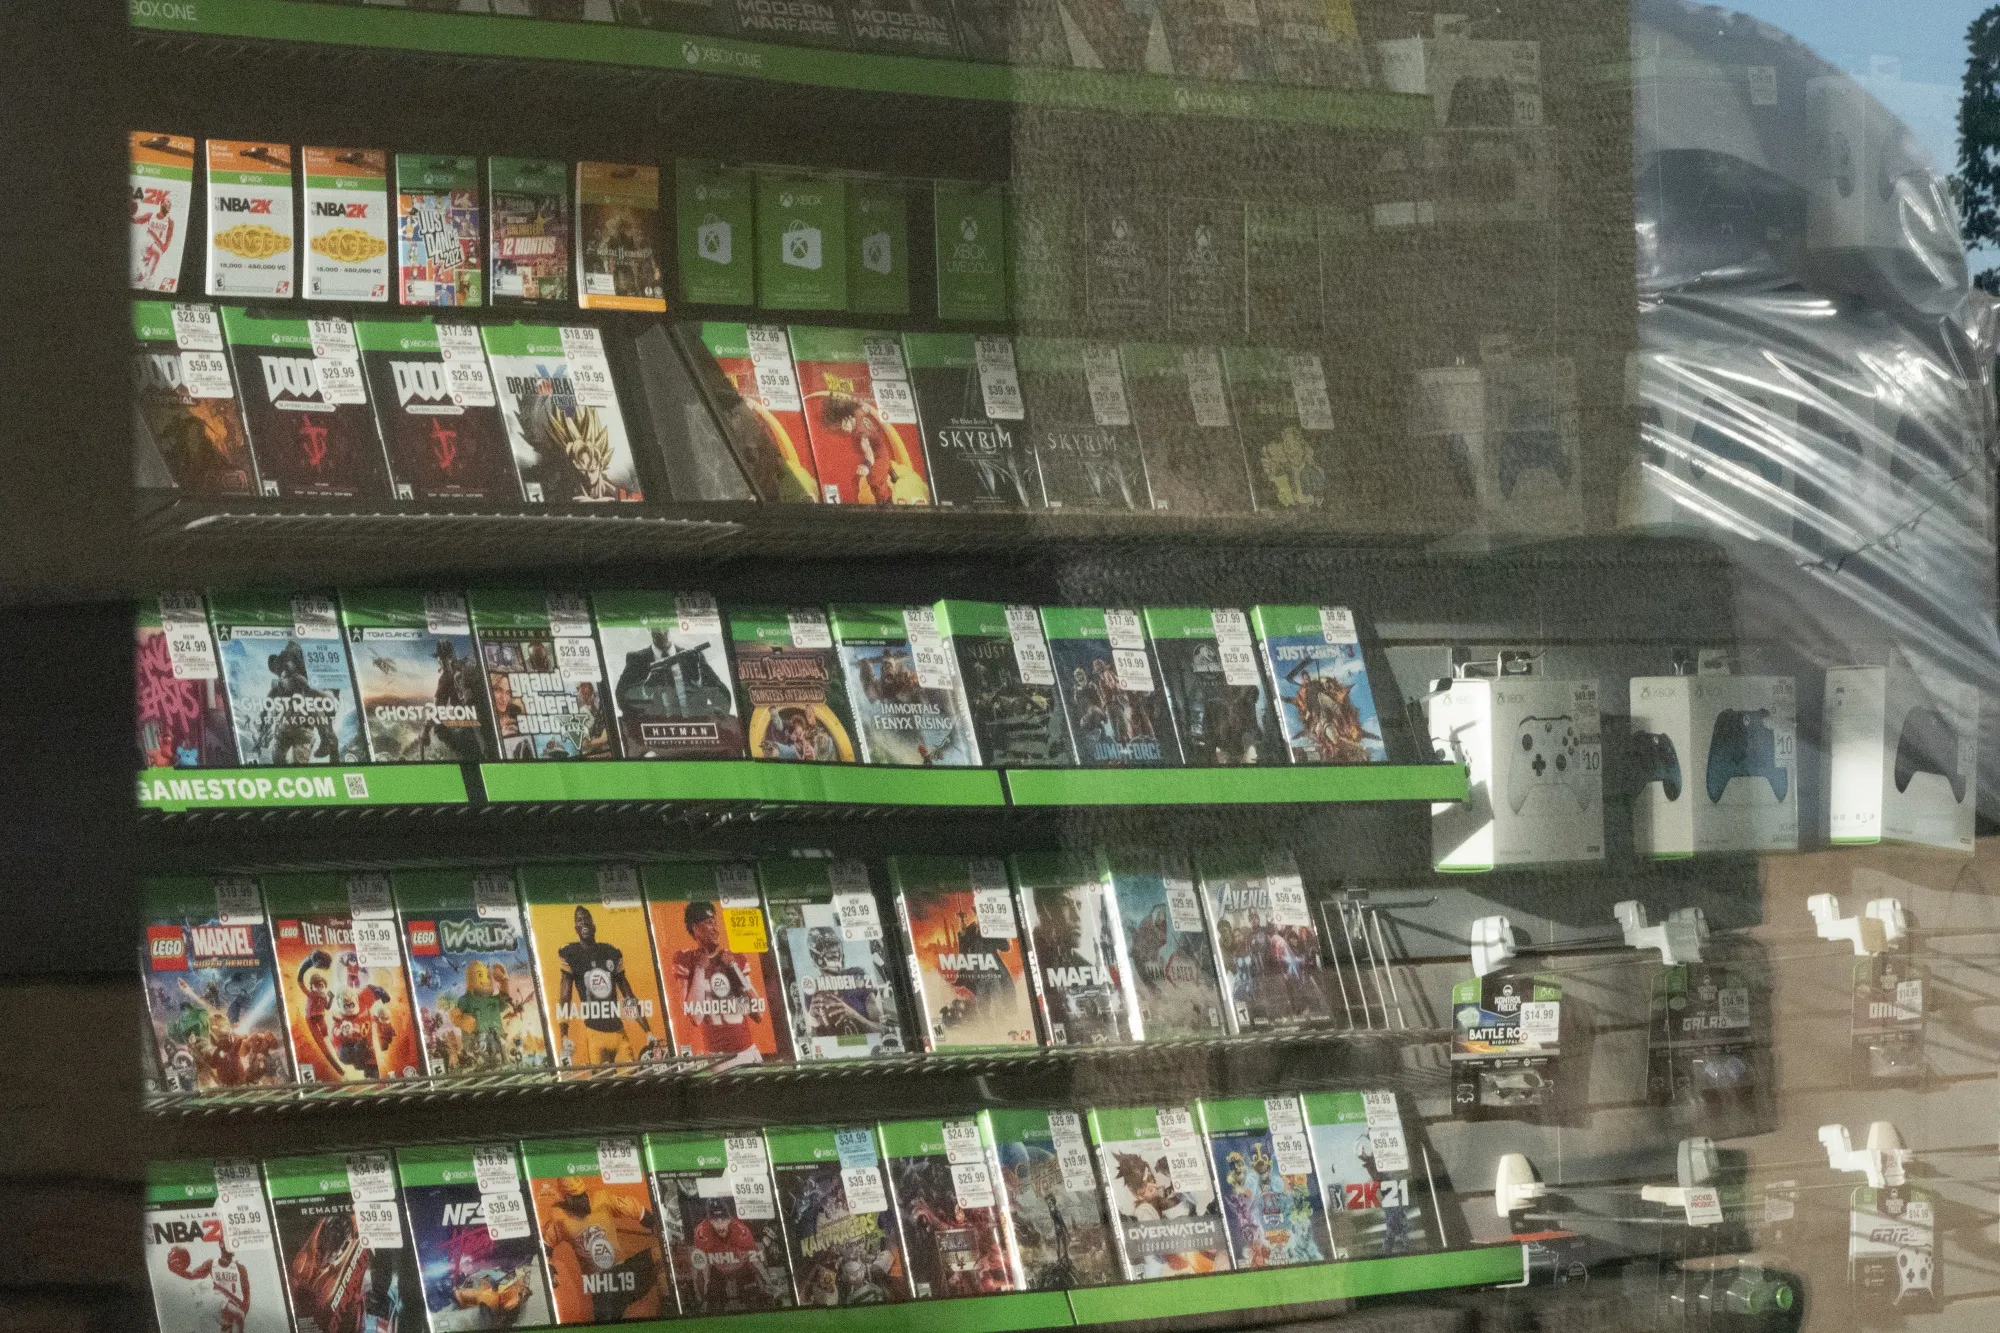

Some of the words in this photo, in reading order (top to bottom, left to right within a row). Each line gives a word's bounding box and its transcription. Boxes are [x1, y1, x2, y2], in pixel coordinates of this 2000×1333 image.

[162, 1, 198, 20] ONE
[738, 0, 834, 18] MODERN
[740, 15, 838, 34] WARFARE
[852, 8, 947, 30] MODERN
[856, 25, 950, 46] WARFARE
[702, 48, 732, 62] XBOX
[734, 52, 761, 68] ONE
[419, 211, 446, 233] JUST
[426, 231, 460, 260] DANCE
[503, 238, 514, 253] 12
[515, 237, 556, 255] MONTHS
[953, 243, 987, 260] XBOX
[176, 312, 211, 324] $28.99
[152, 328, 170, 336] XBOX
[315, 322, 348, 334] $17.99
[441, 326, 473, 338] $17.99
[564, 328, 594, 340] $18.99
[750, 331, 780, 342] $22.99
[189, 360, 223, 372] $59.99
[322, 367, 355, 379] $29.99
[452, 370, 483, 382] $29.99
[574, 371, 604, 383] $19.99
[760, 375, 790, 386] $39.99
[879, 388, 907, 400] $39.99
[938, 431, 1013, 454] SKYRIM
[1048, 433, 1117, 457] SKYRIM
[1108, 616, 1135, 626] $17.99
[235, 629, 253, 637] TOM
[888, 627, 903, 635] XBOX
[172, 640, 207, 652] $24.99
[559, 646, 590, 658] $29.99
[307, 652, 340, 664] $39.99
[916, 653, 944, 665] $29.99
[1020, 650, 1045, 661] $19.99
[1223, 652, 1250, 663] $29.99
[1276, 646, 1308, 661] JUST
[1117, 657, 1145, 669] $19.99
[509, 670, 565, 697] grand
[241, 696, 291, 713] GHOST
[288, 694, 342, 715] RECON
[522, 695, 578, 714] theft
[879, 702, 941, 715] IMMORTALS
[374, 705, 424, 722] GHOST
[423, 702, 478, 725] RECON
[254, 716, 338, 726] BREAKPOINT
[517, 715, 562, 734] auto
[874, 715, 914, 730] FENYX
[915, 715, 954, 730] RISING
[652, 727, 709, 737] HITMAN
[138, 776, 336, 801] GAMESTOP.COM
[1275, 893, 1302, 904] $59.99
[842, 905, 870, 917] $29.99
[979, 904, 1007, 915] $39.99
[731, 916, 760, 928] $22.97
[280, 926, 299, 938] LEGO
[302, 921, 322, 946] THE
[358, 929, 390, 941] $19.99
[412, 931, 435, 944] LEGO
[152, 940, 182, 956] LEGO
[191, 926, 254, 958] MARVEL
[224, 959, 260, 967] HEROES
[938, 953, 999, 971] MAFIA
[818, 975, 856, 989] MADDEN
[1046, 965, 1112, 988] MAFIA
[555, 1000, 620, 1020] MADDEN
[637, 1001, 653, 1017] 19
[683, 1000, 737, 1016] MADDEN
[751, 998, 765, 1013] 20
[1524, 1010, 1554, 1020] $14.99
[1468, 1028, 1505, 1040] BATTLE
[1367, 1094, 1391, 1105] $49.99
[1268, 1100, 1293, 1112] $29.99
[1160, 1113, 1186, 1126] $29.99
[838, 1133, 867, 1145] $34.99
[947, 1127, 975, 1139] $24.99
[728, 1138, 758, 1150] $49.99
[1277, 1141, 1302, 1152] $39.99
[1373, 1137, 1399, 1149] $59.99
[601, 1147, 632, 1158] $12.99
[1063, 1155, 1087, 1167] $19.99
[1171, 1158, 1198, 1169] $39.99
[848, 1175, 877, 1187] $39.99
[957, 1172, 985, 1184] $29.99
[194, 1186, 213, 1195] XBOX
[736, 1183, 765, 1195] $59.99
[488, 1201, 520, 1214] $39.99
[1690, 1201, 1717, 1209] PRODUCT
[228, 1212, 261, 1225] $59.99
[359, 1211, 393, 1222] $39.99
[1128, 1221, 1216, 1239] OVERWATCH
[708, 1251, 740, 1264] NHL
[582, 1272, 618, 1294] NHL
[618, 1271, 636, 1290] 19
